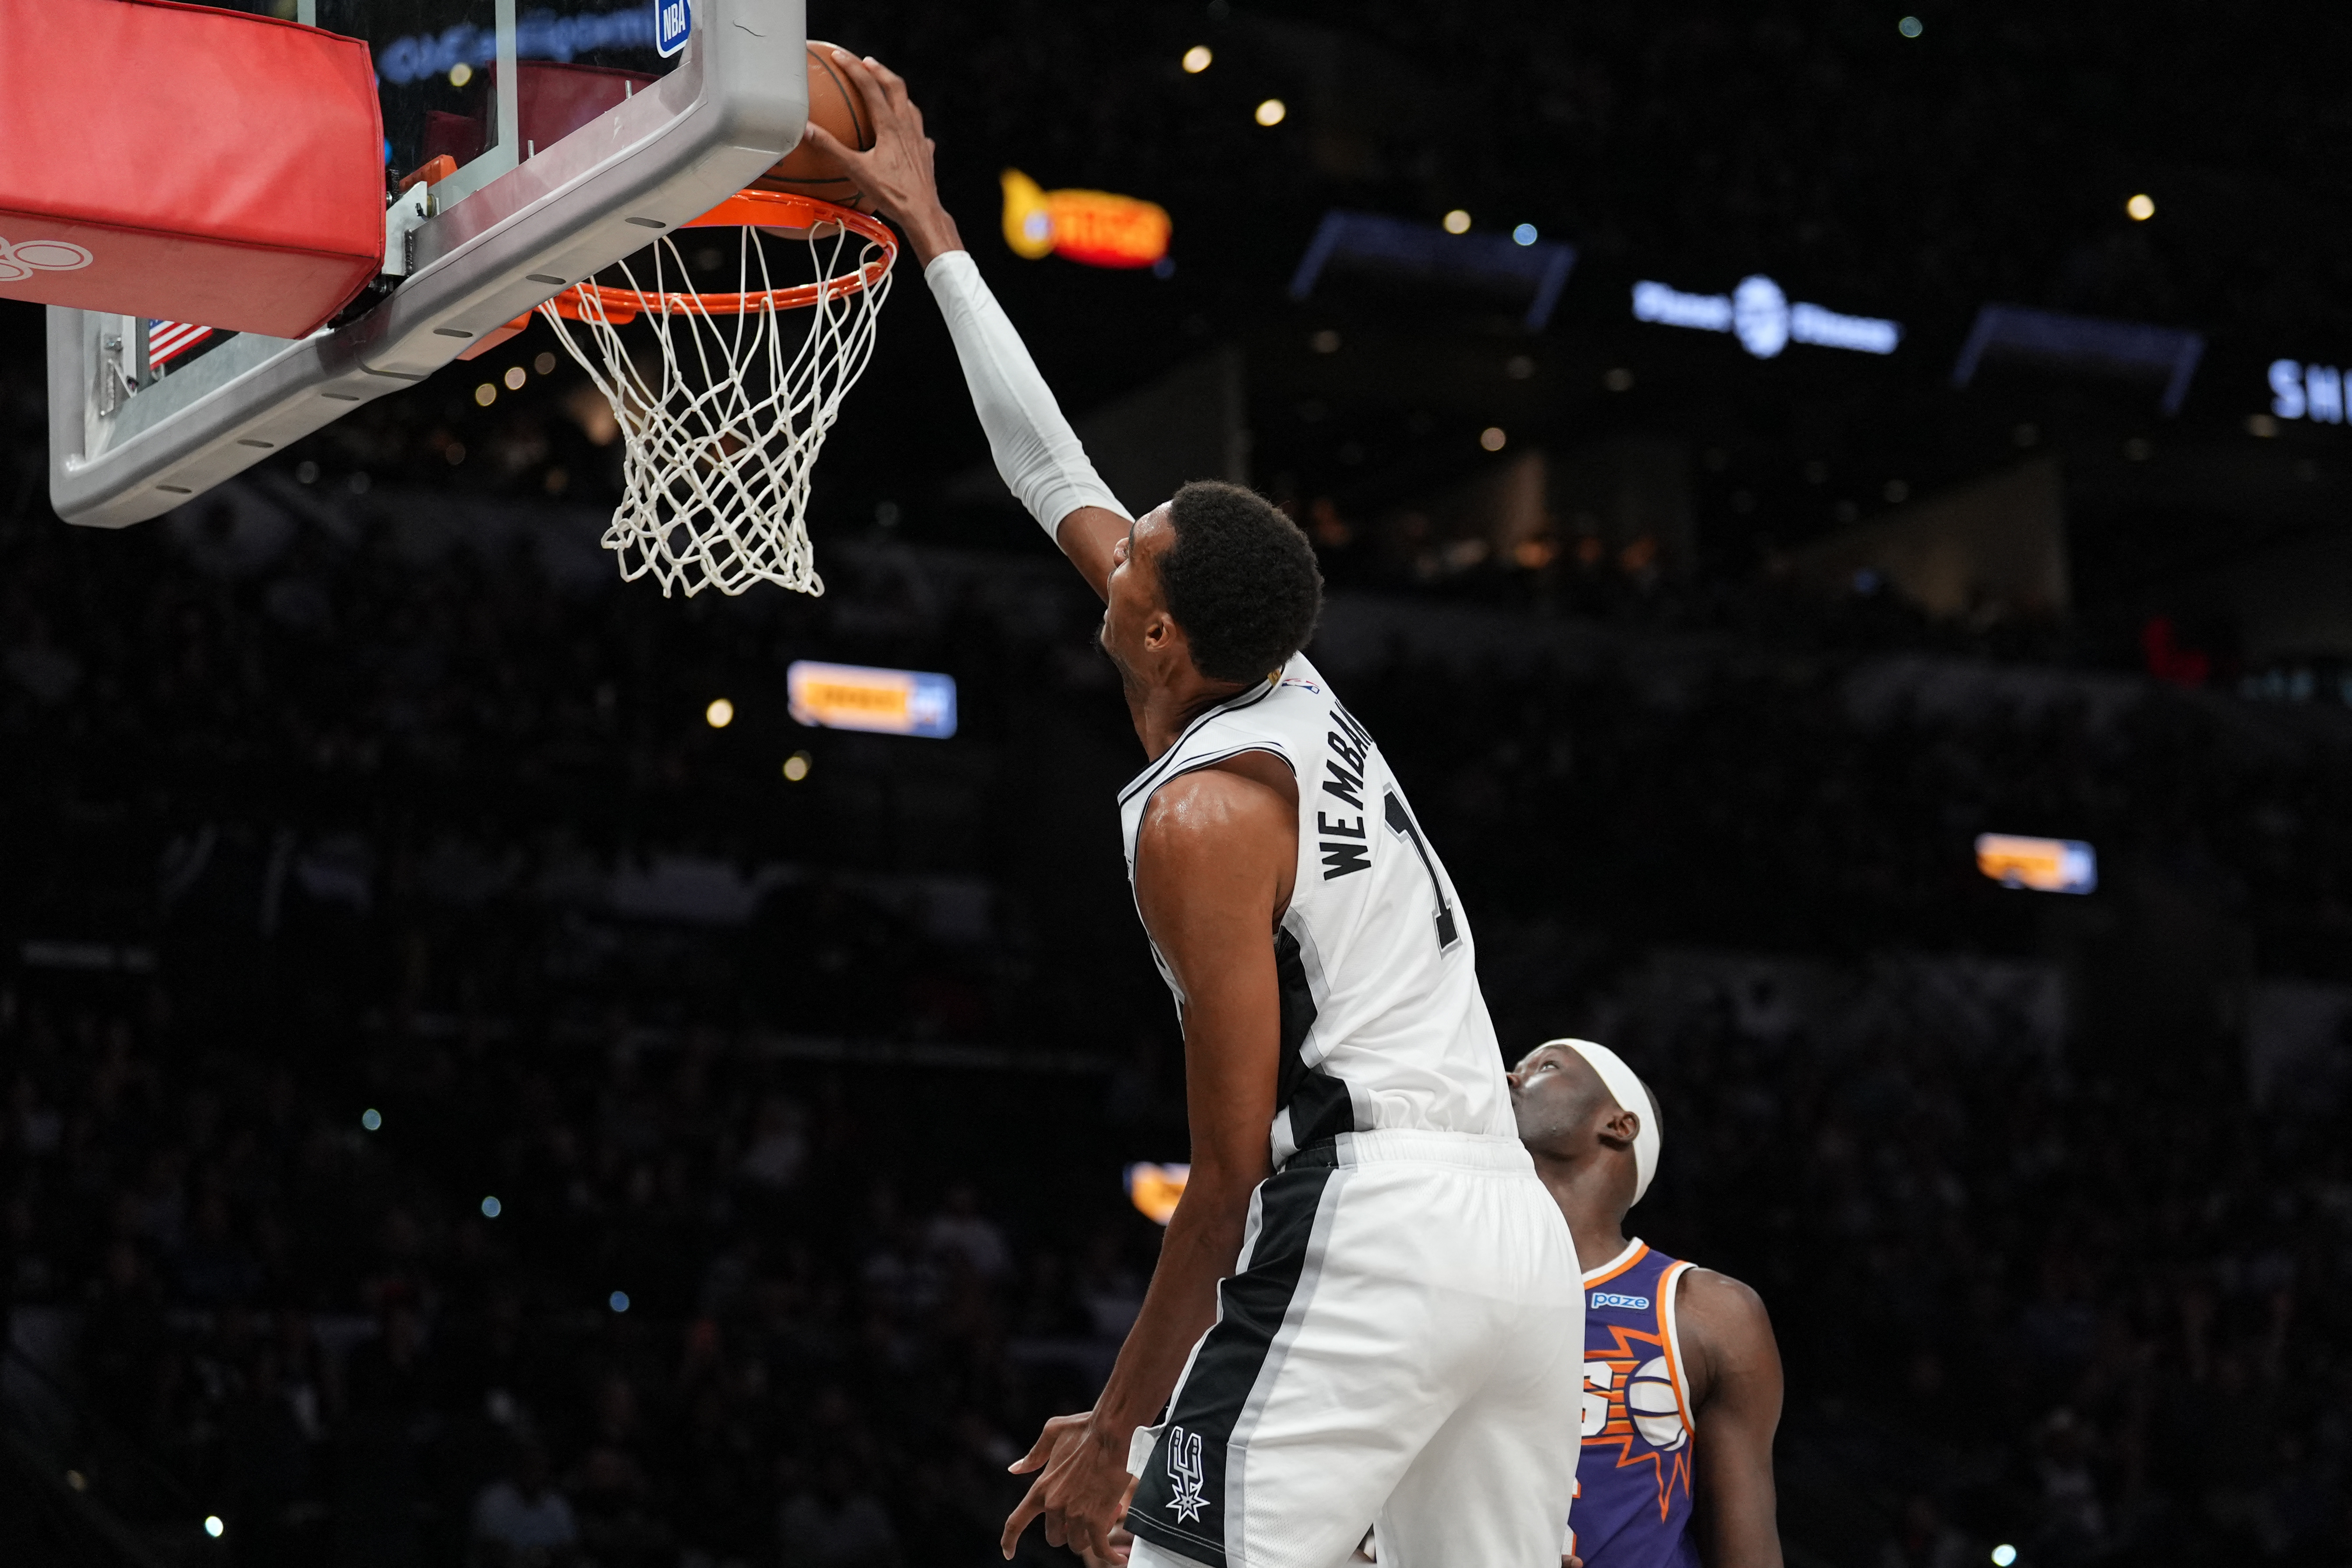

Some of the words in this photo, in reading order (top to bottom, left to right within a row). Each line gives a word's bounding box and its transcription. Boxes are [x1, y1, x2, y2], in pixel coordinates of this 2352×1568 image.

[663, 0, 686, 42] NBA
[1318, 698, 1376, 881] WEMBAN
[1383, 782, 1463, 960] 1
[1593, 1294, 1648, 1308] paze
